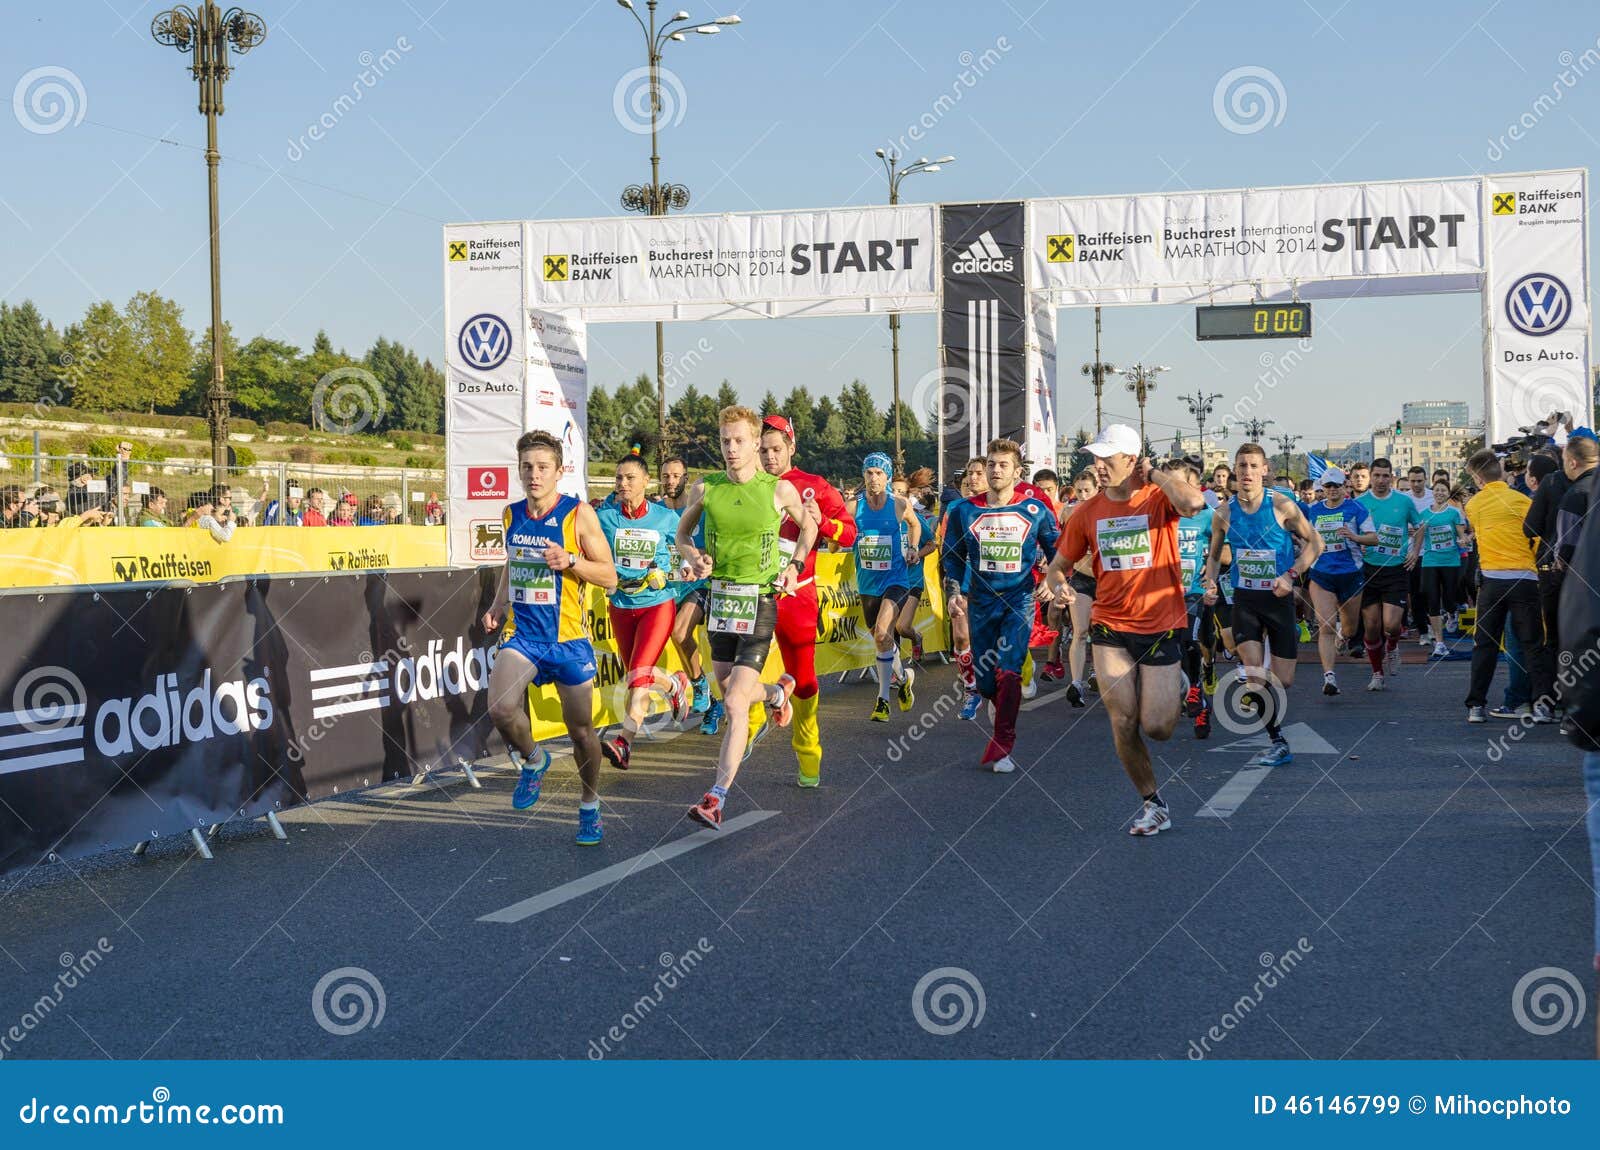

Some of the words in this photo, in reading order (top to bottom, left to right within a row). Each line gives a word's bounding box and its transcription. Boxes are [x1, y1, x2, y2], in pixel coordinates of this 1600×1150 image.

[1519, 189, 1581, 201] Raiffeisen
[1520, 202, 1558, 214] BANK
[1164, 227, 1236, 240] Bucharest
[1241, 221, 1317, 237] International
[1321, 214, 1465, 252] START
[469, 239, 520, 249] Raiffeisen
[1078, 232, 1153, 246] Raiffeisen
[470, 251, 501, 260] BANK
[649, 249, 713, 261] Bucharest
[717, 246, 786, 259] International
[1078, 248, 1124, 262] BANK
[1164, 240, 1266, 259] MARATHON
[1275, 238, 1317, 254] 2014
[571, 253, 638, 266] Raiffeisen
[790, 238, 919, 276] START
[649, 262, 740, 278] MARATHON
[749, 261, 786, 276] 2014
[952, 256, 1014, 274] adidas
[572, 268, 612, 281] BANK
[1504, 350, 1533, 363] Das
[1537, 348, 1579, 362] Auto.
[458, 382, 481, 393] Das
[484, 382, 519, 393] Auto.
[471, 489, 506, 497] vodafone
[619, 540, 652, 552] R53/A
[981, 545, 1020, 558] R497/D
[140, 553, 212, 578] Raiffeisen
[829, 616, 859, 643] BANK
[94, 666, 274, 758] adidas
